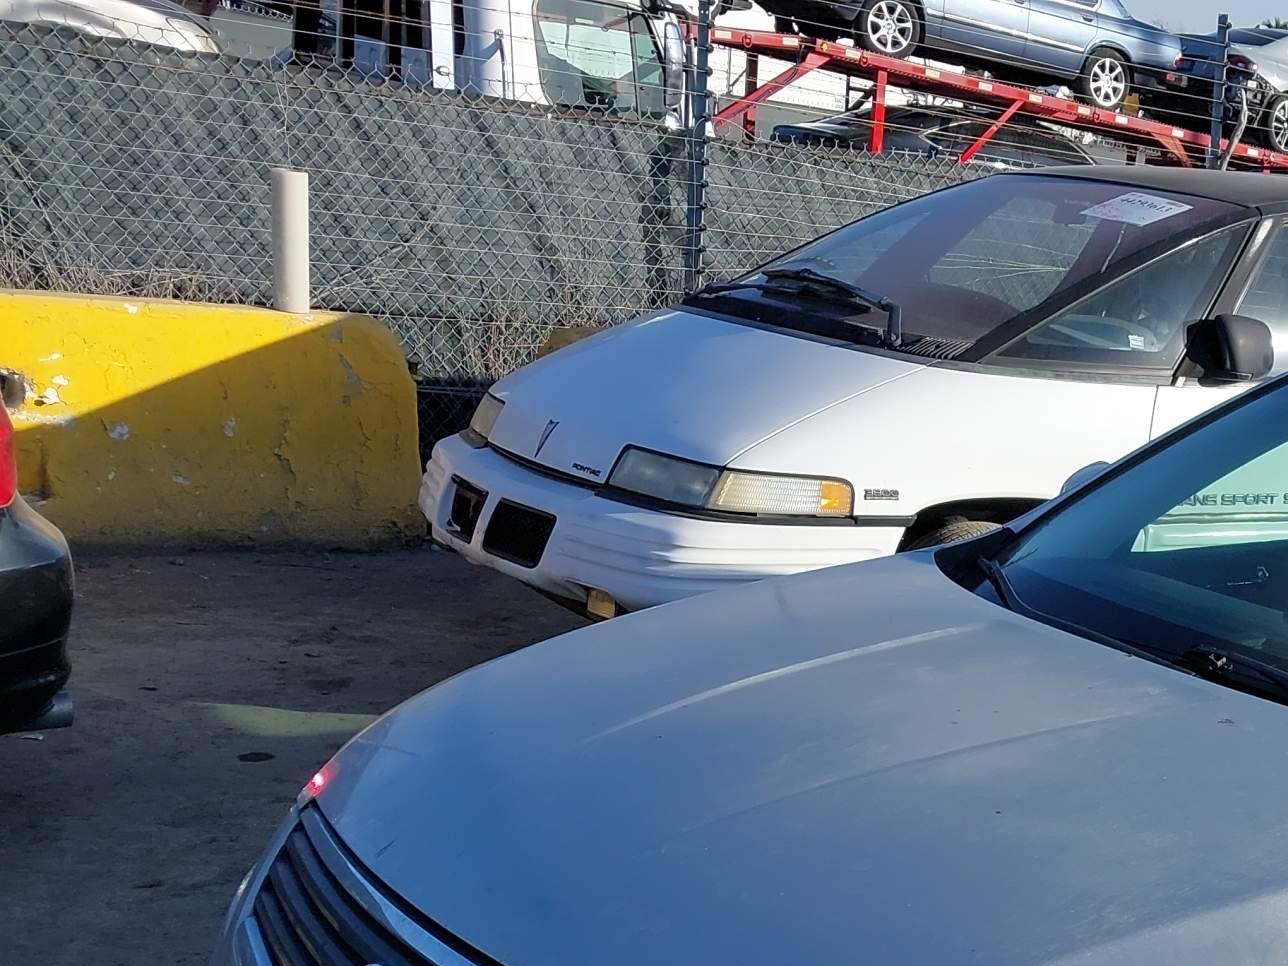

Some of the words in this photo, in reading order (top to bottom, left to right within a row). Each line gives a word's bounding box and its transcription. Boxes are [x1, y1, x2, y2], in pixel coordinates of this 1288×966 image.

[572, 462, 601, 477] PONTIAC
[1178, 494, 1217, 506] ANS
[1220, 493, 1279, 506] SPORT
